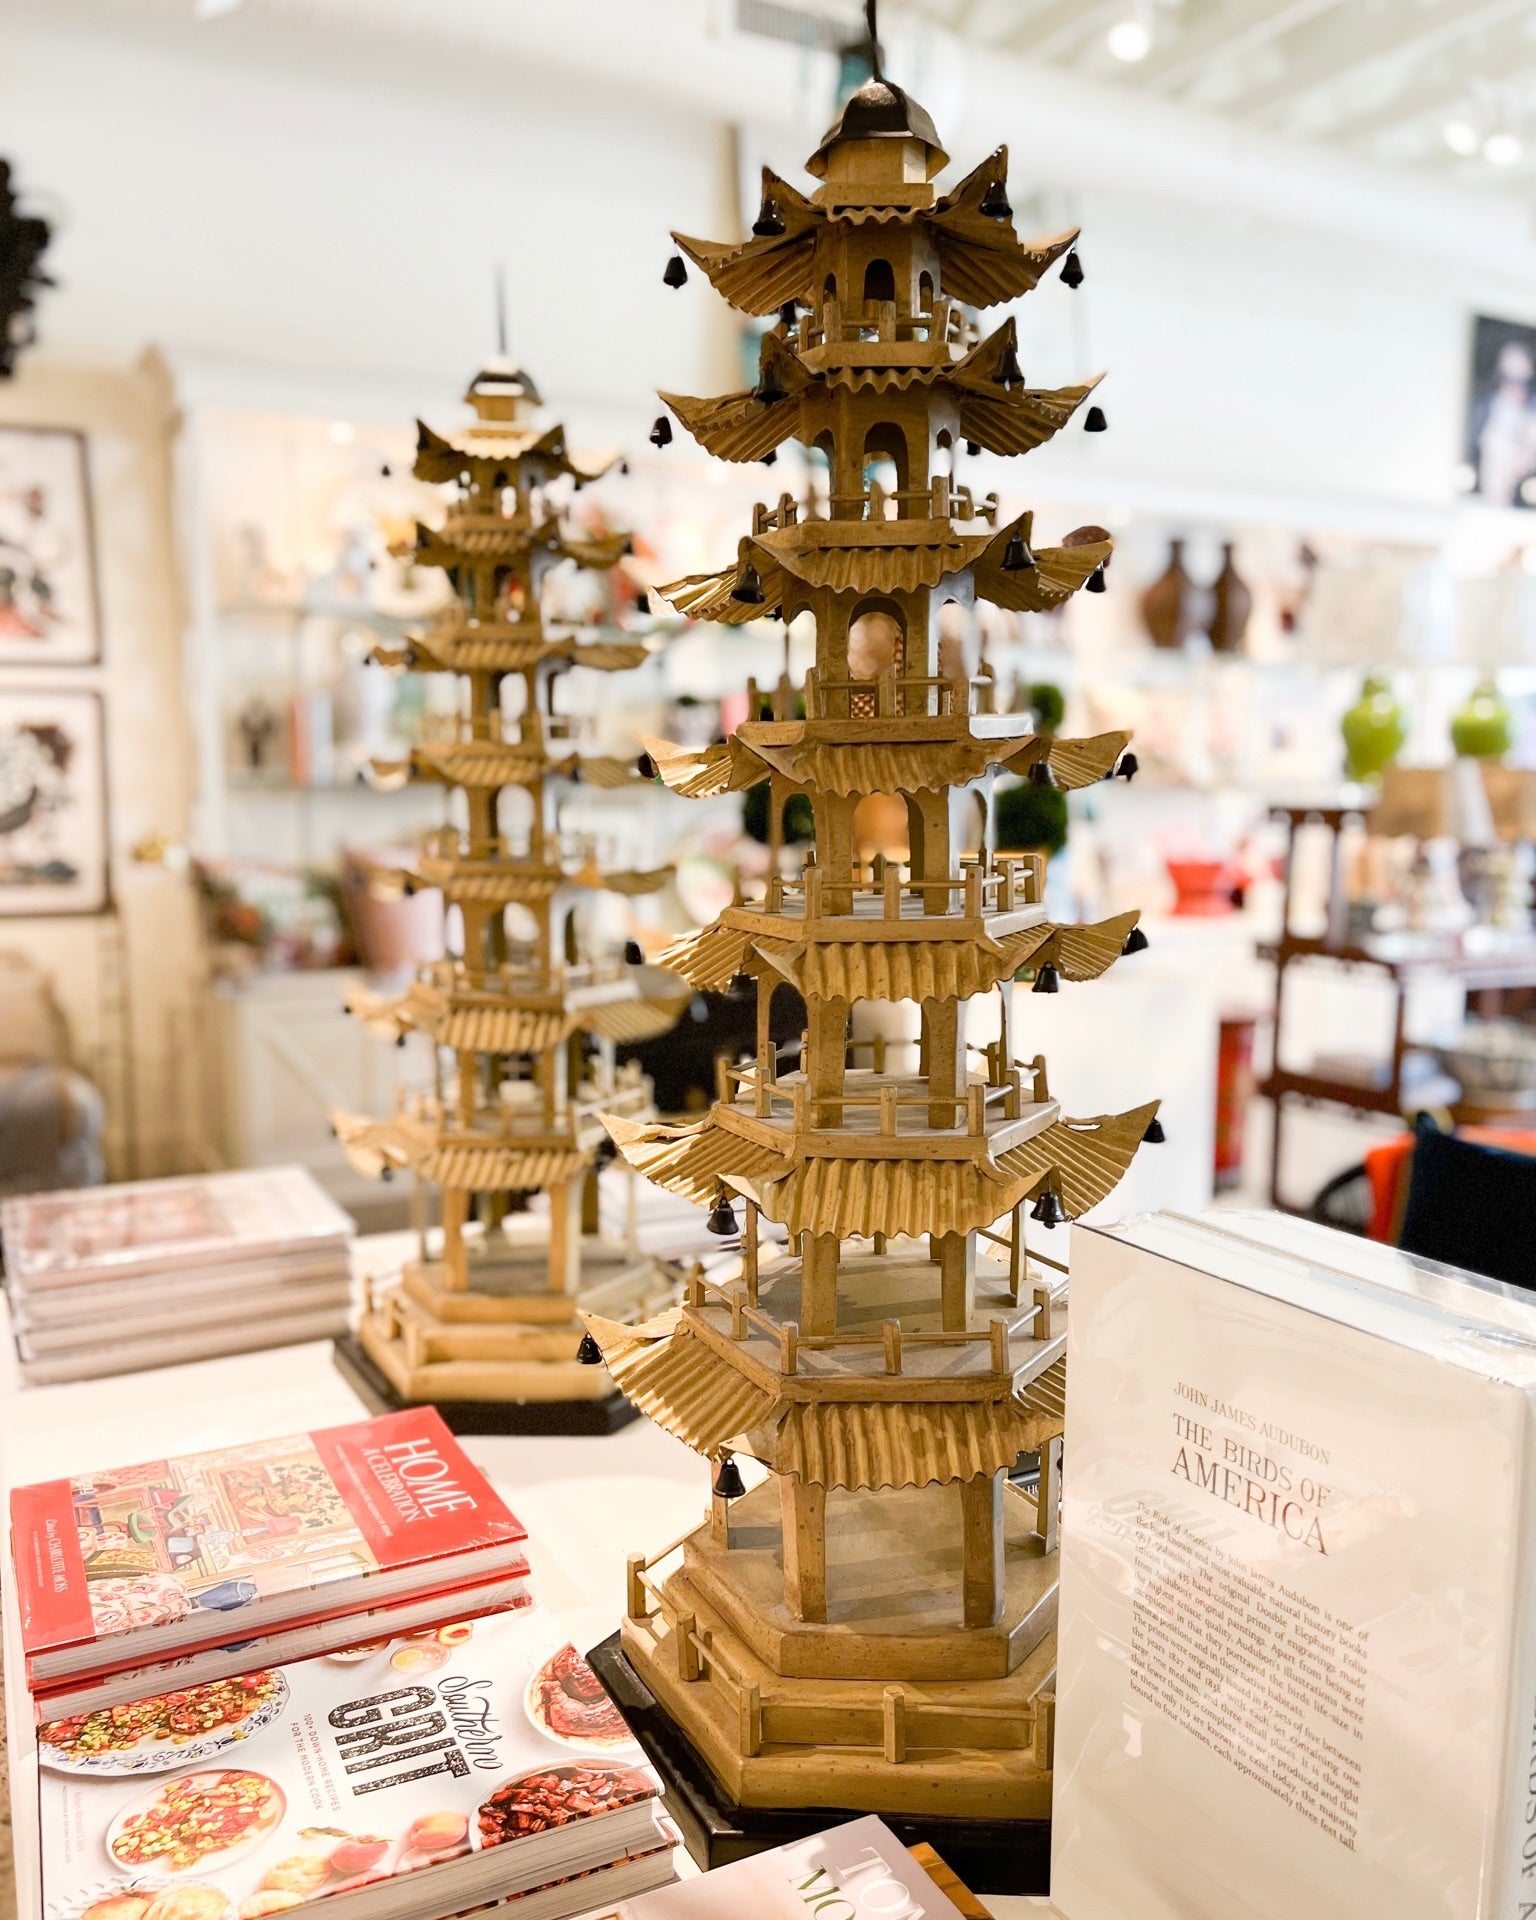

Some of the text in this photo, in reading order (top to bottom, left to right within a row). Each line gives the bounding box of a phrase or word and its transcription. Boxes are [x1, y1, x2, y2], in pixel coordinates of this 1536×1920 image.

[362, 1448, 382, 1456] A
[1172, 1412, 1331, 1508] THE BIRDS OF
[1174, 1382, 1330, 1465] JOHN JAMES AUDUBON
[367, 1454, 426, 1523] CELEBRATION
[384, 1437, 478, 1518] HOME
[1170, 1446, 1328, 1556] AMERICA
[48, 1538, 66, 1574] CHARLOTTE
[52, 1574, 69, 1593] MOSS
[1150, 1522, 1164, 1538] bst
[1195, 1552, 1208, 1564] and
[1212, 1562, 1230, 1578] most
[1234, 1575, 1265, 1598] valuable
[1270, 1597, 1300, 1619] natural
[1304, 1614, 1336, 1640] history
[1340, 1636, 1367, 1658] books
[1216, 1546, 1224, 1560] by
[1279, 1586, 1319, 1613] Audubon
[1325, 1611, 1332, 1621] is
[1336, 1619, 1353, 1631] one
[1358, 1632, 1369, 1641] of
[1133, 1600, 1158, 1620] natura
[1194, 1642, 1208, 1654] and
[1210, 1652, 1217, 1660] in
[1220, 1657, 1238, 1674] their
[1241, 1672, 1265, 1692] native
[1193, 1578, 1243, 1616] hand-colored
[1247, 1615, 1271, 1633] prints
[1275, 1632, 1284, 1640] of
[1288, 1640, 1335, 1672] engravings
[1340, 1671, 1365, 1690] made
[1200, 1567, 1213, 1582] The
[1220, 1583, 1249, 1604] original
[1257, 1603, 1287, 1626] Double
[1295, 1625, 1334, 1655] Elephant
[1344, 1654, 1367, 1674] Folio
[1133, 1611, 1146, 1626] The
[1148, 1624, 1169, 1641] prints
[1171, 1640, 1187, 1655] were
[1189, 1653, 1224, 1681] originally
[1253, 1696, 1261, 1705] in
[1293, 1723, 1303, 1732] of
[1305, 1728, 1320, 1743] five
[1323, 1739, 1361, 1771] between
[1133, 1627, 1143, 1639] the
[1147, 1638, 1165, 1653] years
[1187, 1667, 1201, 1679] and
[1250, 1709, 1269, 1726] each
[1274, 1725, 1285, 1736] set
[1291, 1737, 1338, 1775] containing
[1343, 1773, 1360, 1788] one
[1177, 1614, 1184, 1623] in
[1188, 1621, 1202, 1635] that
[1206, 1633, 1222, 1650] they
[1227, 1648, 1265, 1676] portrayed
[1270, 1674, 1283, 1688] the
[1288, 1684, 1309, 1705] birds
[1354, 1729, 1363, 1740] in
[1205, 1619, 1233, 1641] quality,
[1237, 1638, 1279, 1670] Audubon's
[1284, 1668, 1337, 1706] illustrations
[1342, 1705, 1364, 1723] were
[1272, 1644, 1294, 1663] Apart
[1300, 1660, 1321, 1680] from
[1326, 1675, 1351, 1700] being
[1355, 1697, 1365, 1707] of
[290, 1722, 323, 1810] FOR THE MODERN COOK
[304, 1713, 341, 1812] 100+ DOWN-HOME RECIPES
[328, 1685, 471, 1796] GRIT
[437, 1676, 504, 1770] Southern
[1131, 1669, 1138, 1677] of
[1141, 1675, 1158, 1692] these
[1162, 1691, 1176, 1706] only
[1193, 1716, 1204, 1725] are
[1208, 1722, 1234, 1747] known
[1238, 1746, 1246, 1756] to
[1302, 1791, 1315, 1805] the
[1320, 1805, 1357, 1836] majority
[1131, 1680, 1356, 1851] bound in four volumes, each approximately three feet tall.
[1132, 1654, 1145, 1668] that
[1147, 1664, 1166, 1682] fewer
[1168, 1680, 1183, 1696] than
[1201, 1706, 1235, 1733] complete
[1278, 1760, 1318, 1791] produced
[1321, 1790, 1337, 1805] and
[1340, 1802, 1357, 1819] that
[1169, 1668, 1200, 1695] medium,
[1221, 1704, 1241, 1723] three
[1245, 1721, 1266, 1739] small
[1323, 1774, 1358, 1803] thought
[836, 1846, 926, 1920] TO
